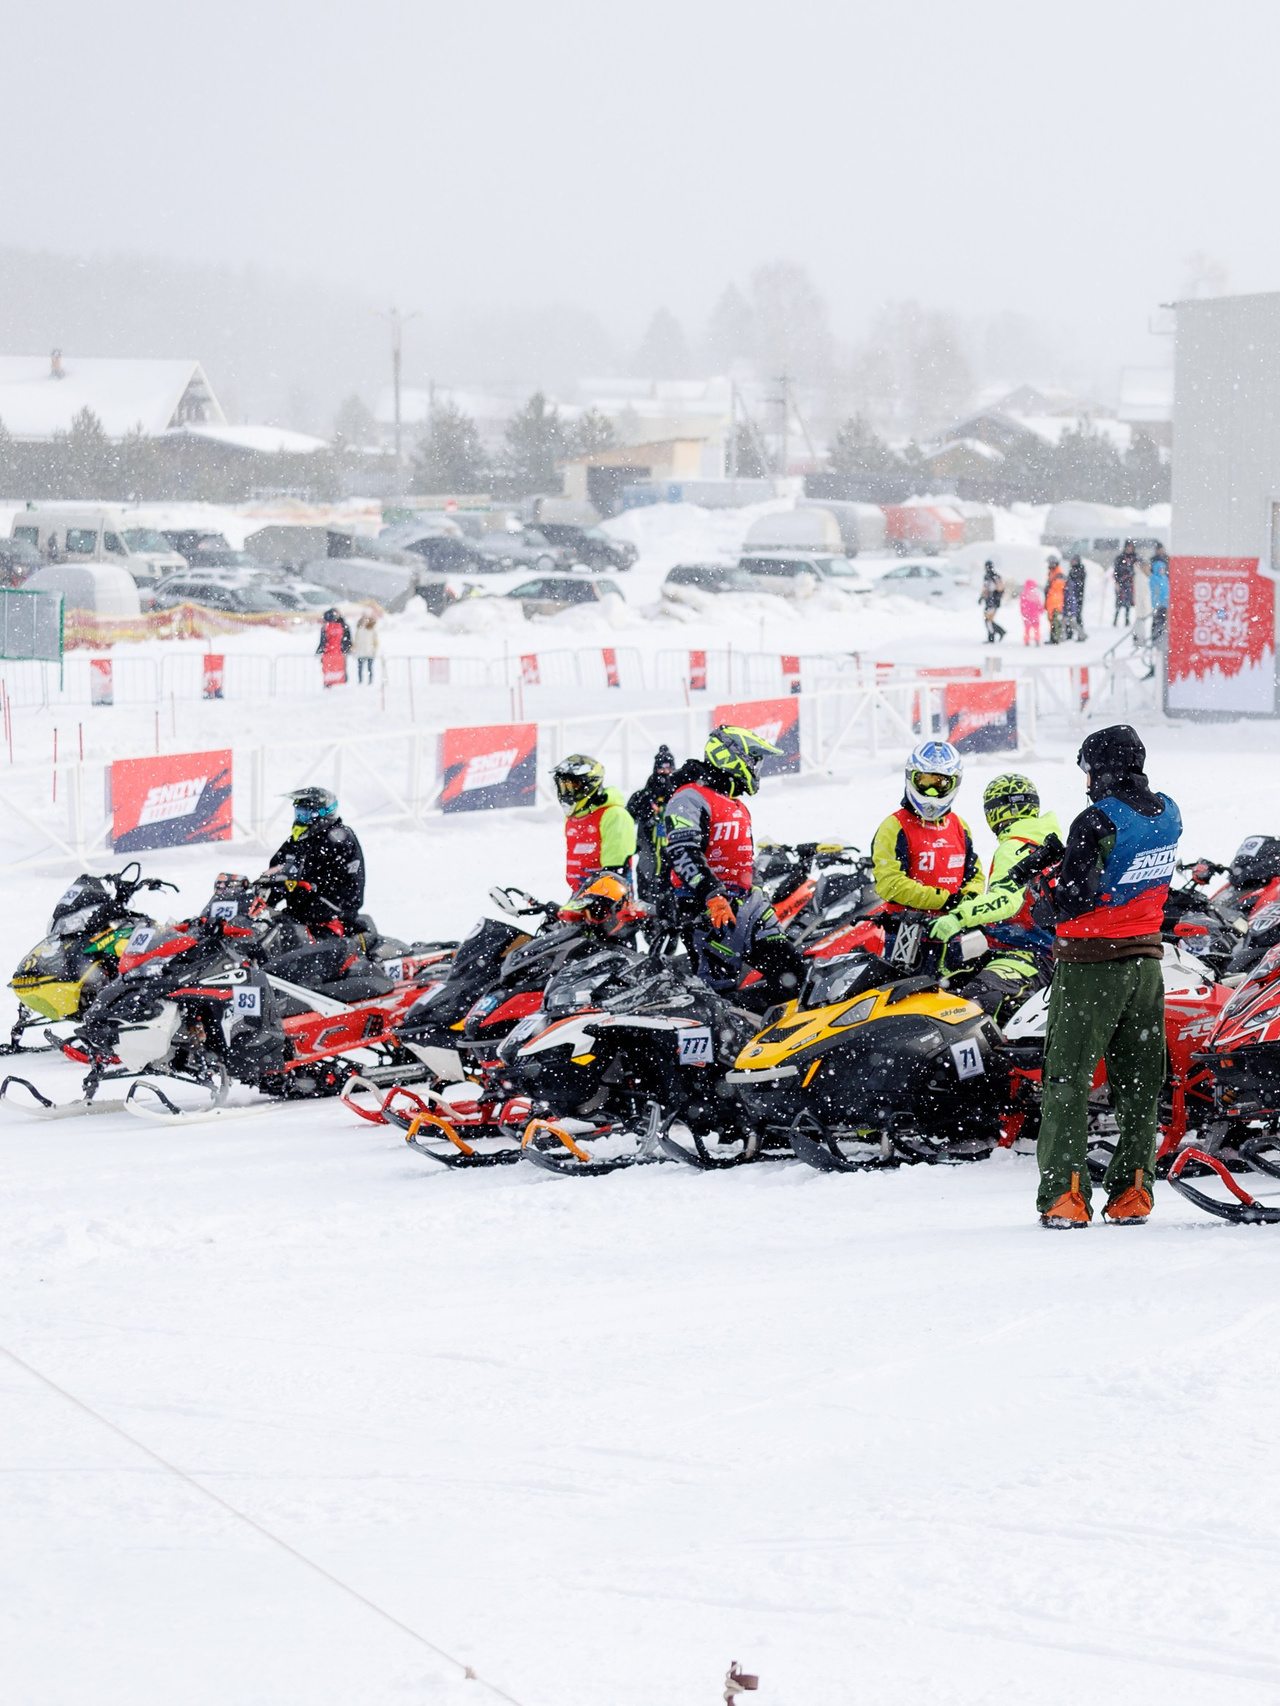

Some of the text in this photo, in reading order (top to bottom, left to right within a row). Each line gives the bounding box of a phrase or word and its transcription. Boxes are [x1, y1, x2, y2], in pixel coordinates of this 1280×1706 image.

[143, 776, 208, 807] SNOW
[713, 820, 740, 841] 777
[1127, 848, 1177, 872] SNOW
[215, 906, 234, 920] 25
[971, 896, 1009, 917] FXR
[135, 932, 149, 949] 89
[389, 965, 402, 979] 25
[238, 992, 256, 1009] 89
[940, 1006, 967, 1018] ski-doo
[683, 1037, 709, 1055] 777
[959, 1047, 976, 1070] 71
